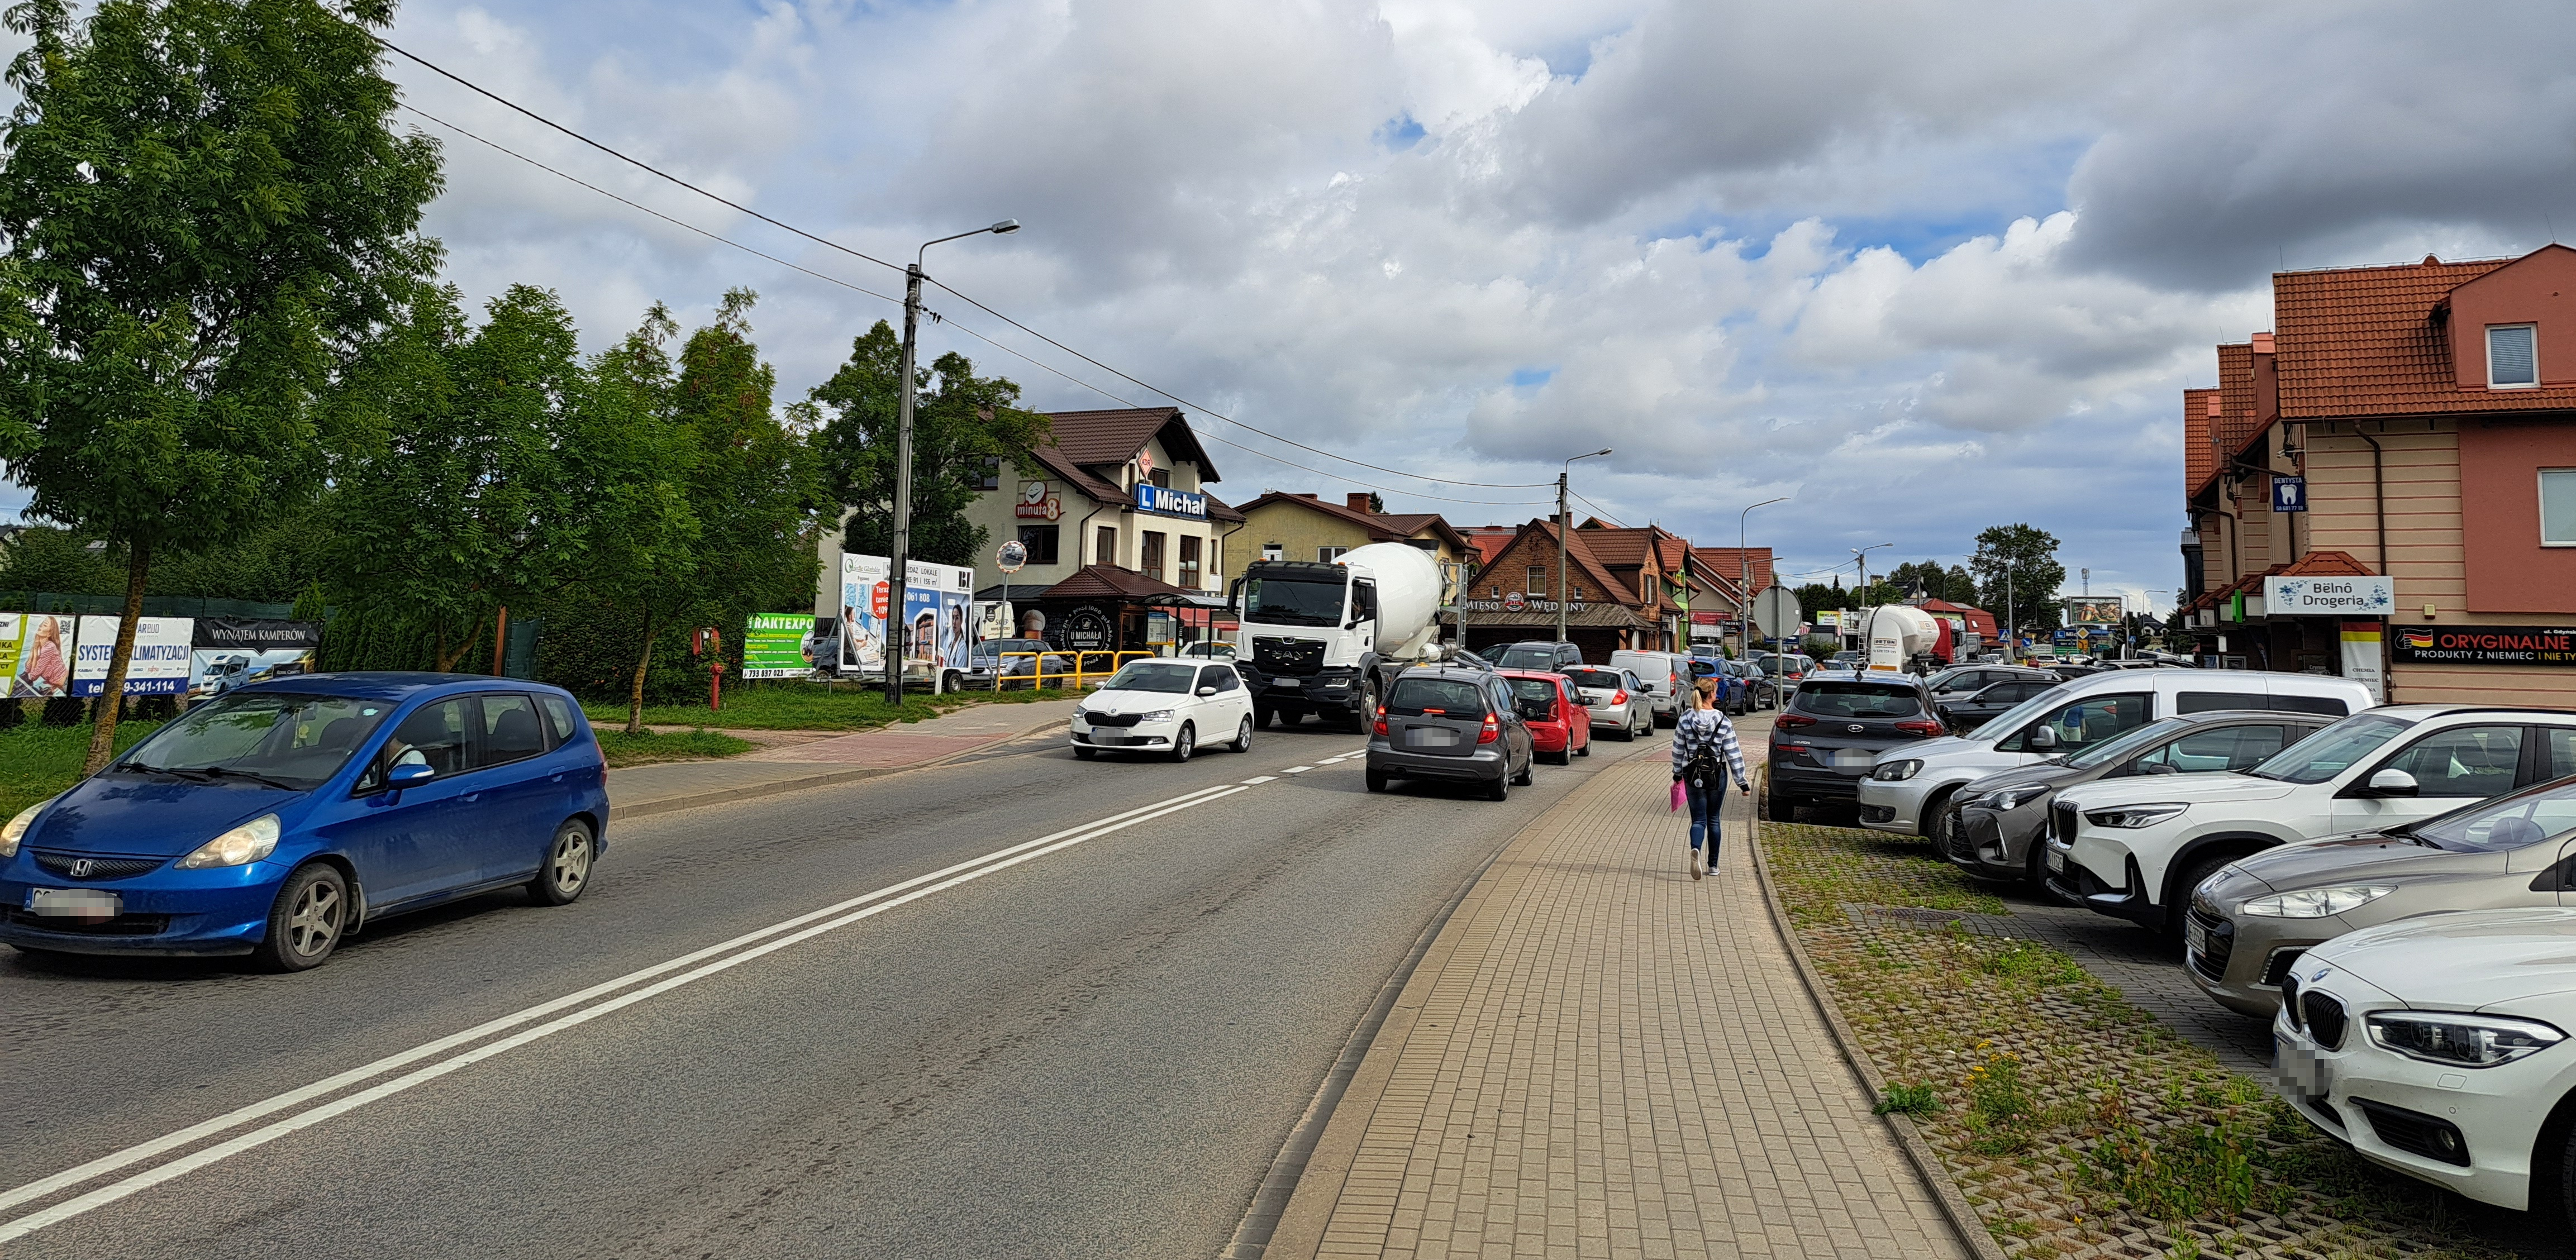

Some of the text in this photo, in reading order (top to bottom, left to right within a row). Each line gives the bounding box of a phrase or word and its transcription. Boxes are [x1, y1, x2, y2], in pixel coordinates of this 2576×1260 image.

[1155, 489, 1206, 516] Michał
[1017, 499, 1059, 520] minuta 8
[2313, 582, 2352, 593] Bëlnô
[1531, 600, 1585, 613] WĘDINY
[2303, 595, 2364, 608] Drogeria
[1088, 605, 1102, 614] 1000
[137, 623, 159, 633] ARBUD
[212, 628, 306, 642] WYNAJEM KAMPERÓW
[1075, 631, 1102, 640] MICHAŁA
[2440, 634, 2570, 650] ORYGINALNE
[1272, 650, 1304, 659] MAN
[2415, 650, 2473, 658] PRODUKTY
[2487, 652, 2535, 660] NIEMIEC
[122, 680, 175, 693] 9-341-114
